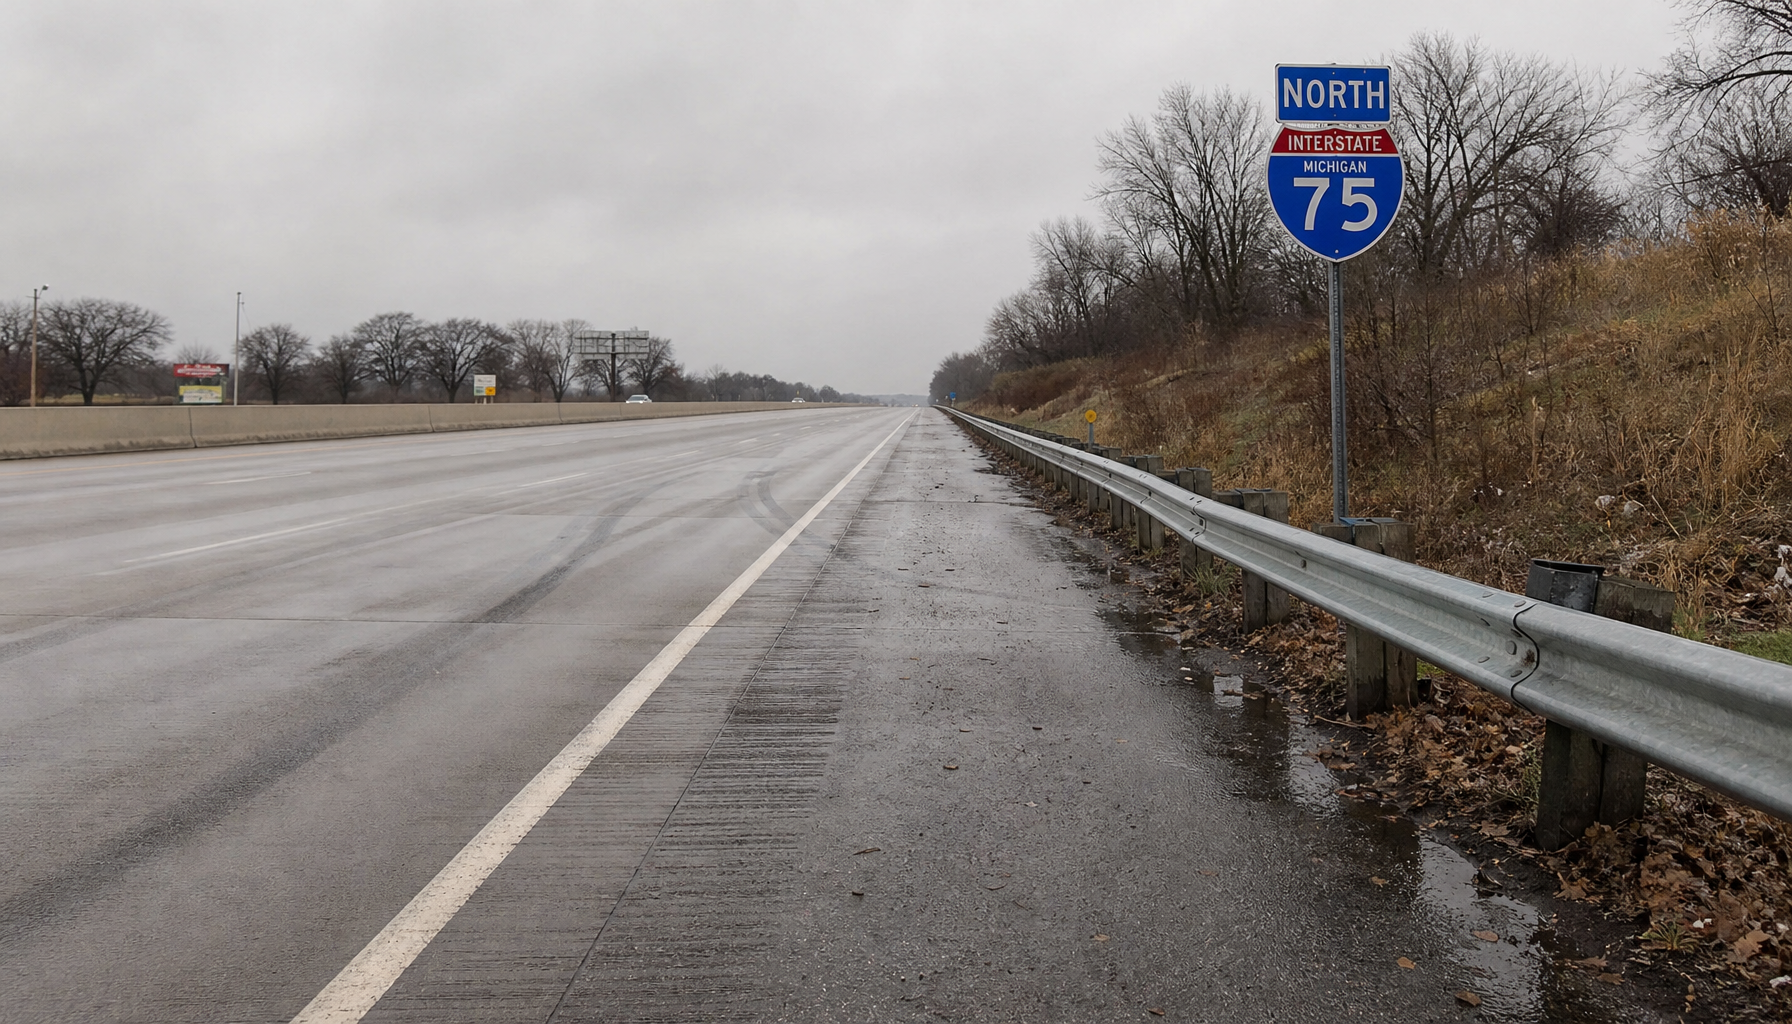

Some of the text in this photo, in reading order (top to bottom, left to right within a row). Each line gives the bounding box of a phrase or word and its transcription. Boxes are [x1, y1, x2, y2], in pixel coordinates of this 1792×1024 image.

[1283, 78, 1385, 109] NORTH
[1288, 135, 1383, 152] INTERSTATE
[1303, 160, 1367, 173] MICHIGAN
[1293, 177, 1378, 232] 75
